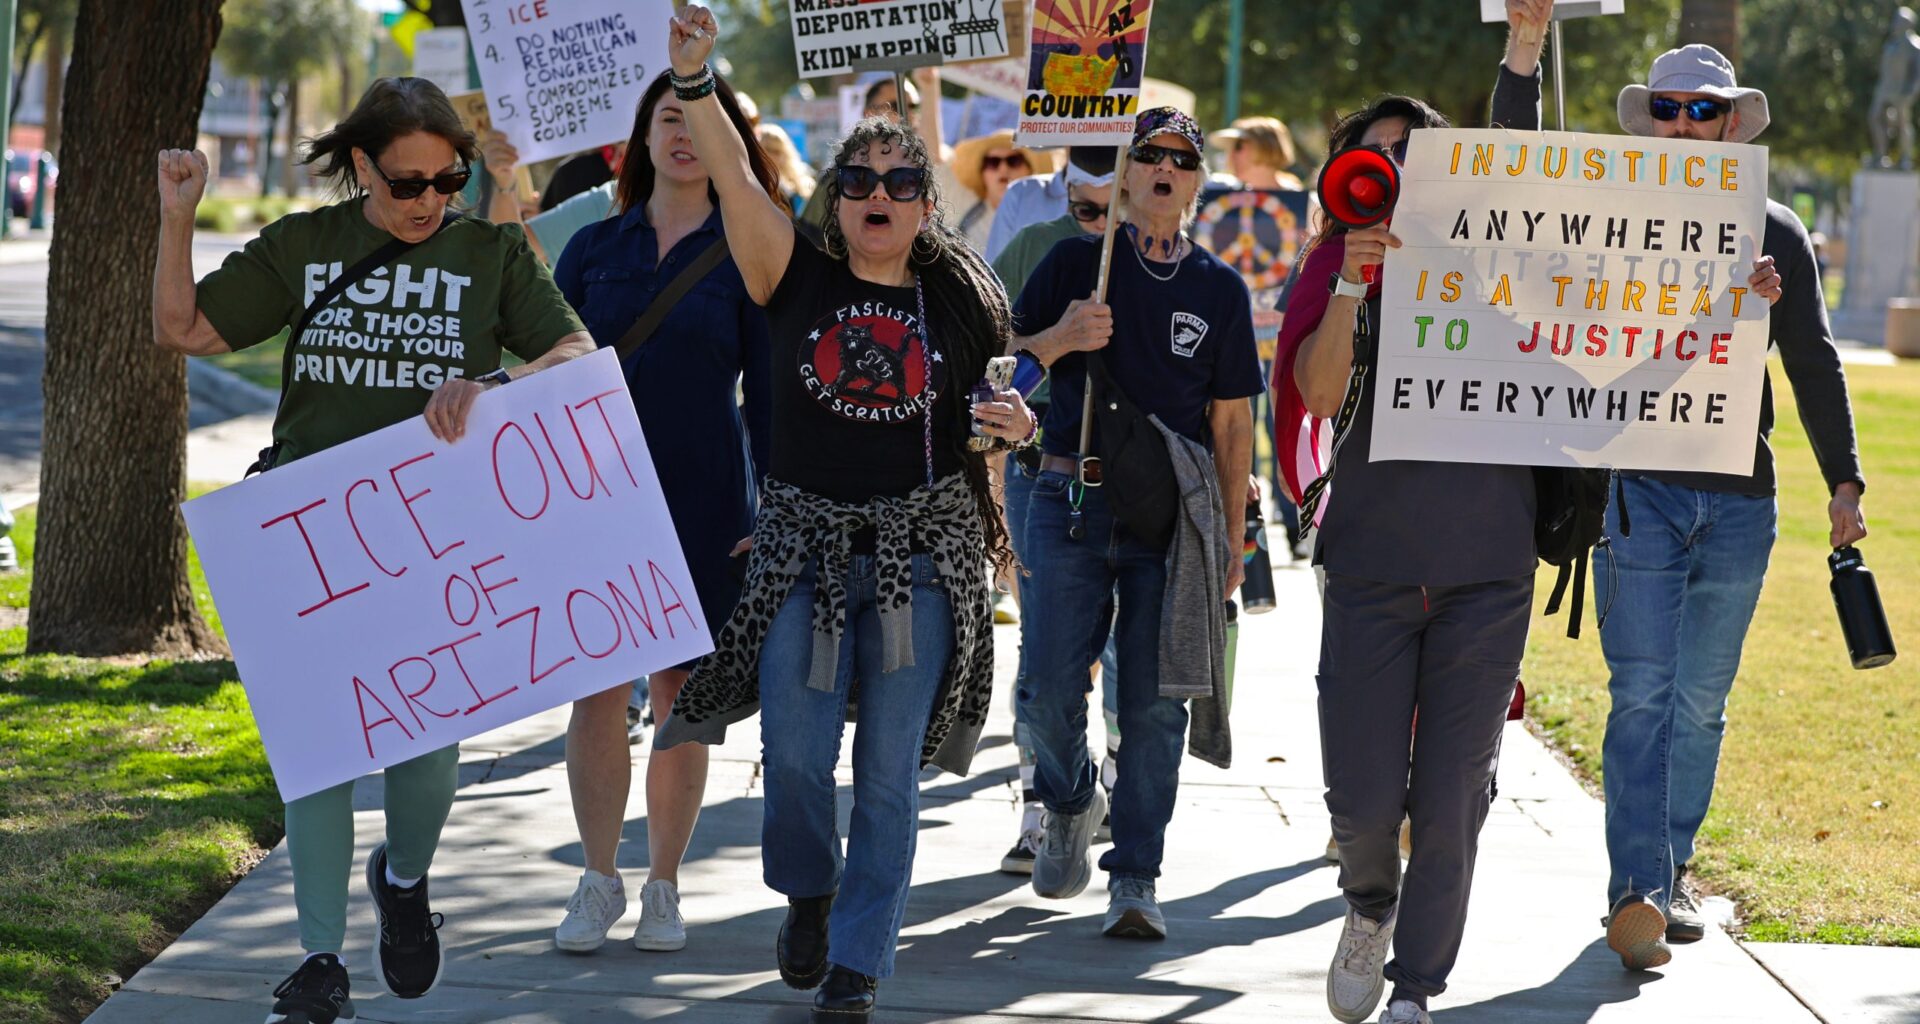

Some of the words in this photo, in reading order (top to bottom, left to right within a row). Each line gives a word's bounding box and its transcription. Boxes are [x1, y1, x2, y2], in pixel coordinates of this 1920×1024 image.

[508, 0, 549, 25] ICE
[515, 33, 545, 55] DO
[552, 13, 626, 44] NOTHING
[522, 29, 638, 72] REPUBLICAN
[801, 34, 957, 72] KIDNAPPING
[525, 52, 617, 88] CONGRESS
[497, 95, 519, 121] 5.
[527, 64, 645, 109] COMPROMIZED
[530, 92, 613, 128] SUPREME
[1025, 93, 1134, 119] COUNTRY
[533, 118, 587, 142] COURT
[1020, 121, 1058, 134] PROTECT
[1059, 121, 1077, 134] OUR
[1449, 142, 1739, 192] INJUSTICE
[1450, 209, 1737, 254] ANYWHERE
[303, 261, 471, 311] FIGHT
[1416, 270, 1464, 303] IS
[1488, 273, 1512, 306] A
[1551, 276, 1748, 318] THREAT
[308, 307, 353, 327] OR
[363, 311, 460, 338] THOSE
[1175, 315, 1204, 333] PARMA
[300, 329, 393, 352] WITHOUT
[401, 338, 464, 360] YOUR
[1414, 316, 1469, 351] TO
[1517, 321, 1733, 365] JUSTICE
[800, 363, 831, 400] GET
[1392, 377, 1727, 424] EVERYWHERE
[261, 451, 465, 617] ICE
[492, 387, 638, 520] OUT
[445, 554, 518, 626] OF
[353, 559, 697, 759] ARIZONA
